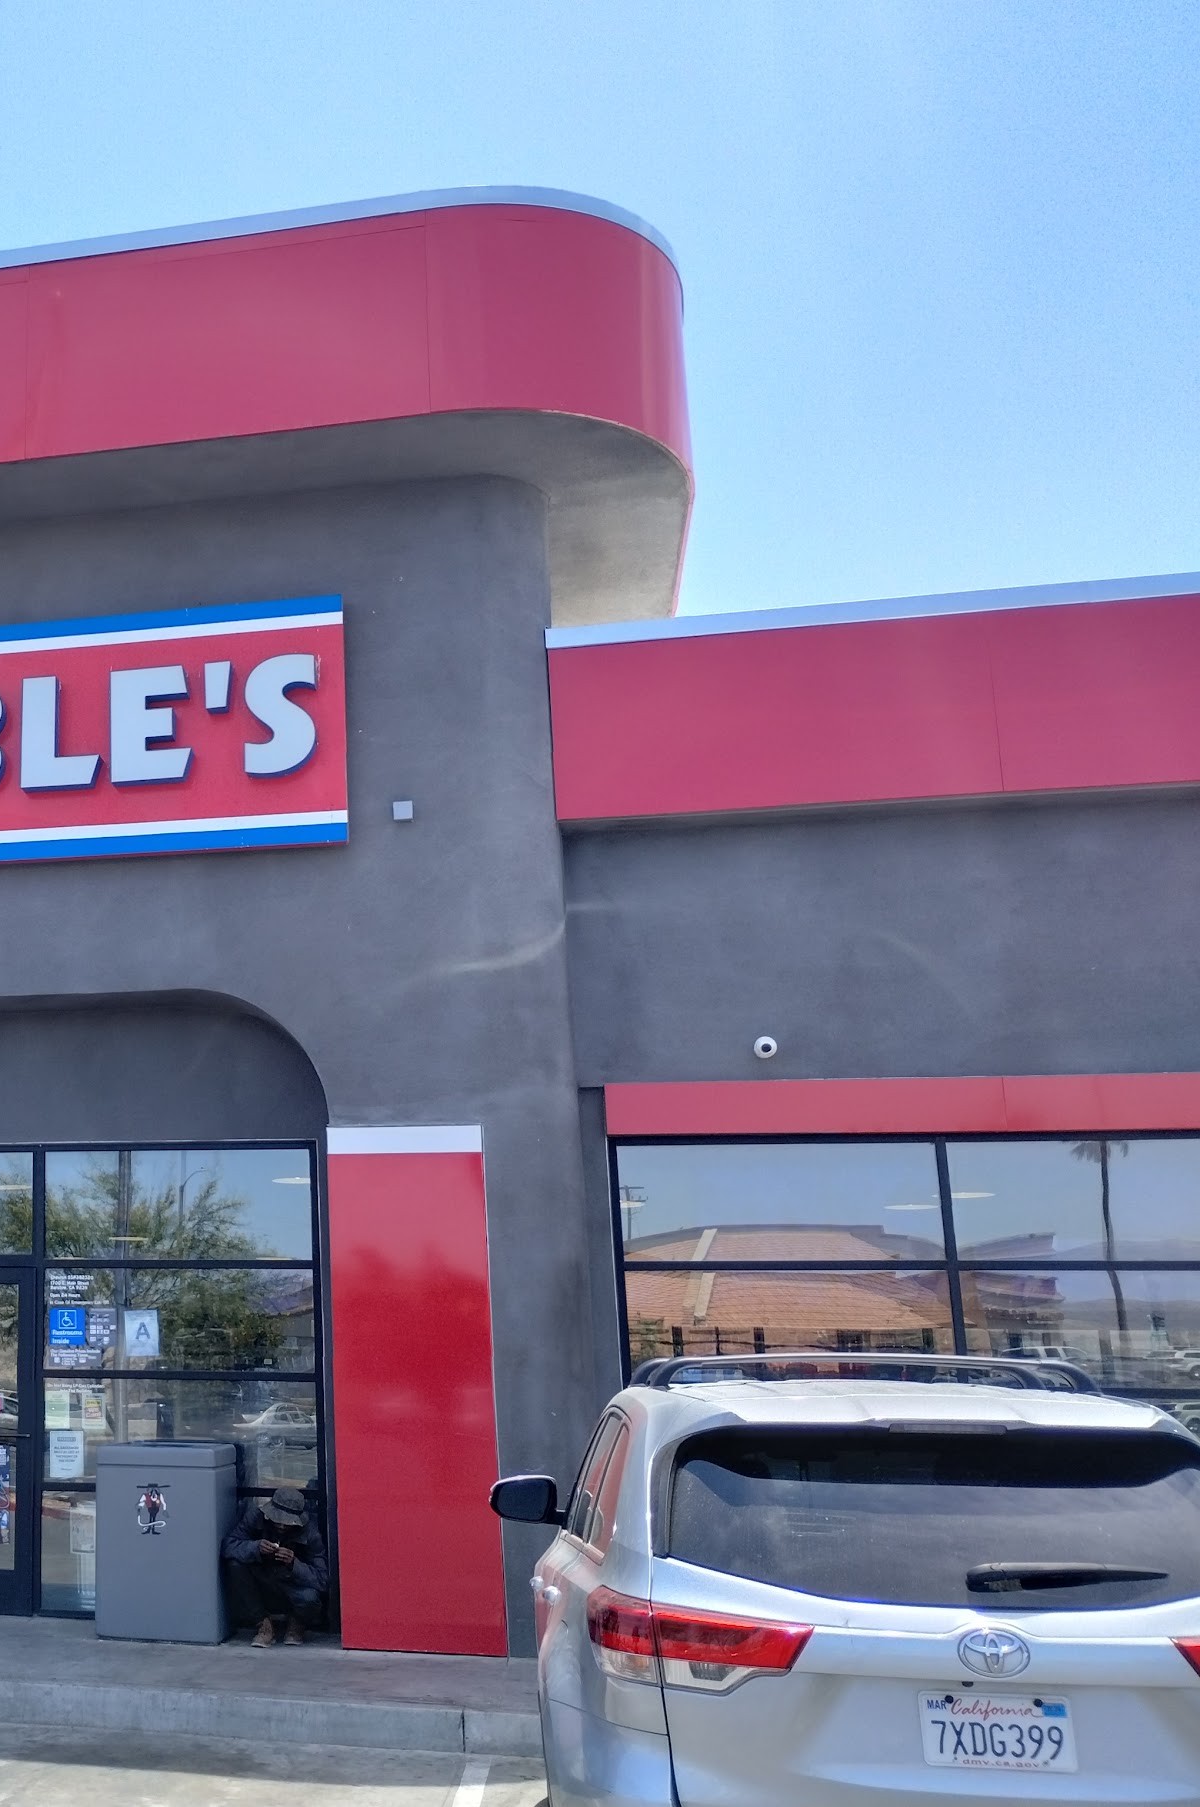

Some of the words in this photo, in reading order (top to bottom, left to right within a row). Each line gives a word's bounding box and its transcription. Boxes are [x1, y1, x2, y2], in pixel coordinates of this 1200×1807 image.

[135, 1321, 151, 1340] A
[927, 1699, 947, 1710] MAR
[950, 1697, 1043, 1721] California
[931, 1719, 1064, 1760] 7XDG399
[962, 1758, 1040, 1768] dmv.ca.gov
